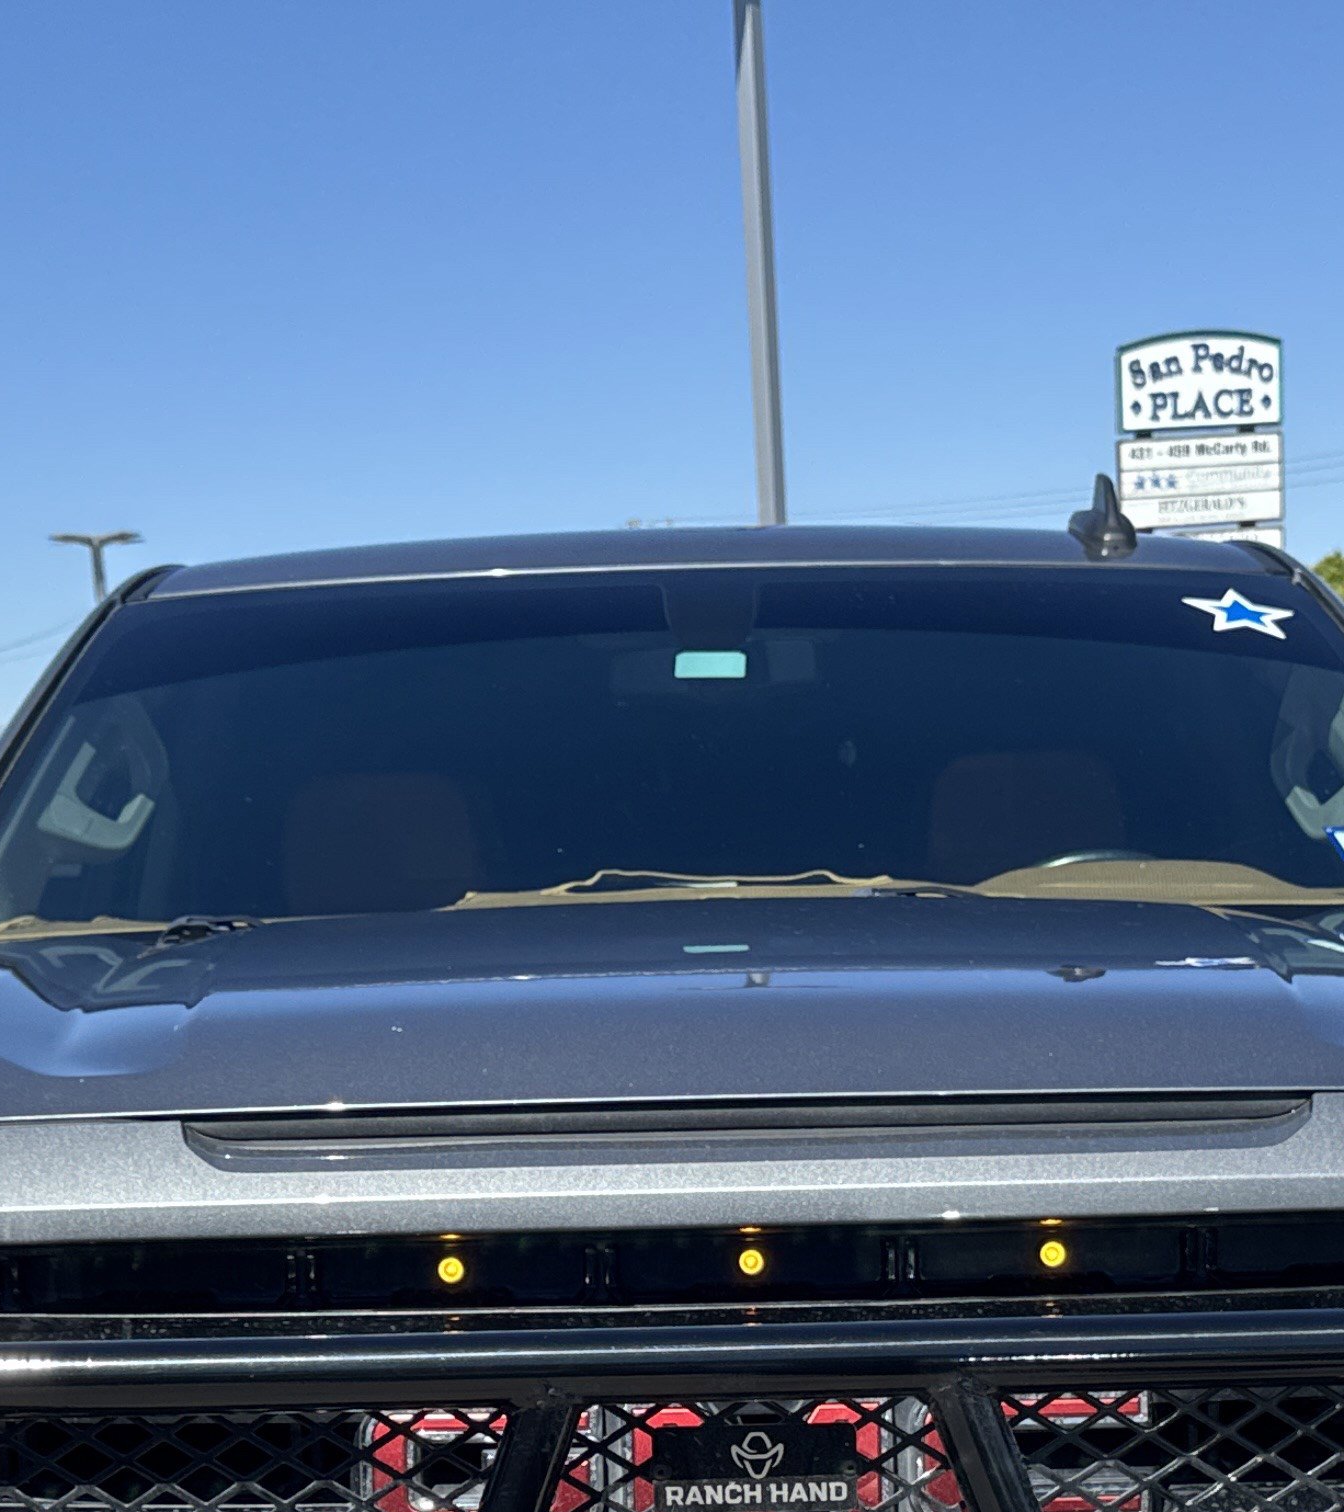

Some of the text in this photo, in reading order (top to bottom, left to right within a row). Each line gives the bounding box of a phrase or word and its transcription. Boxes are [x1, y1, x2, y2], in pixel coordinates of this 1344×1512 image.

[1128, 342, 1275, 389] San Pedro
[1148, 388, 1254, 423] PLACE
[665, 1481, 848, 1506] RANCH HAND
